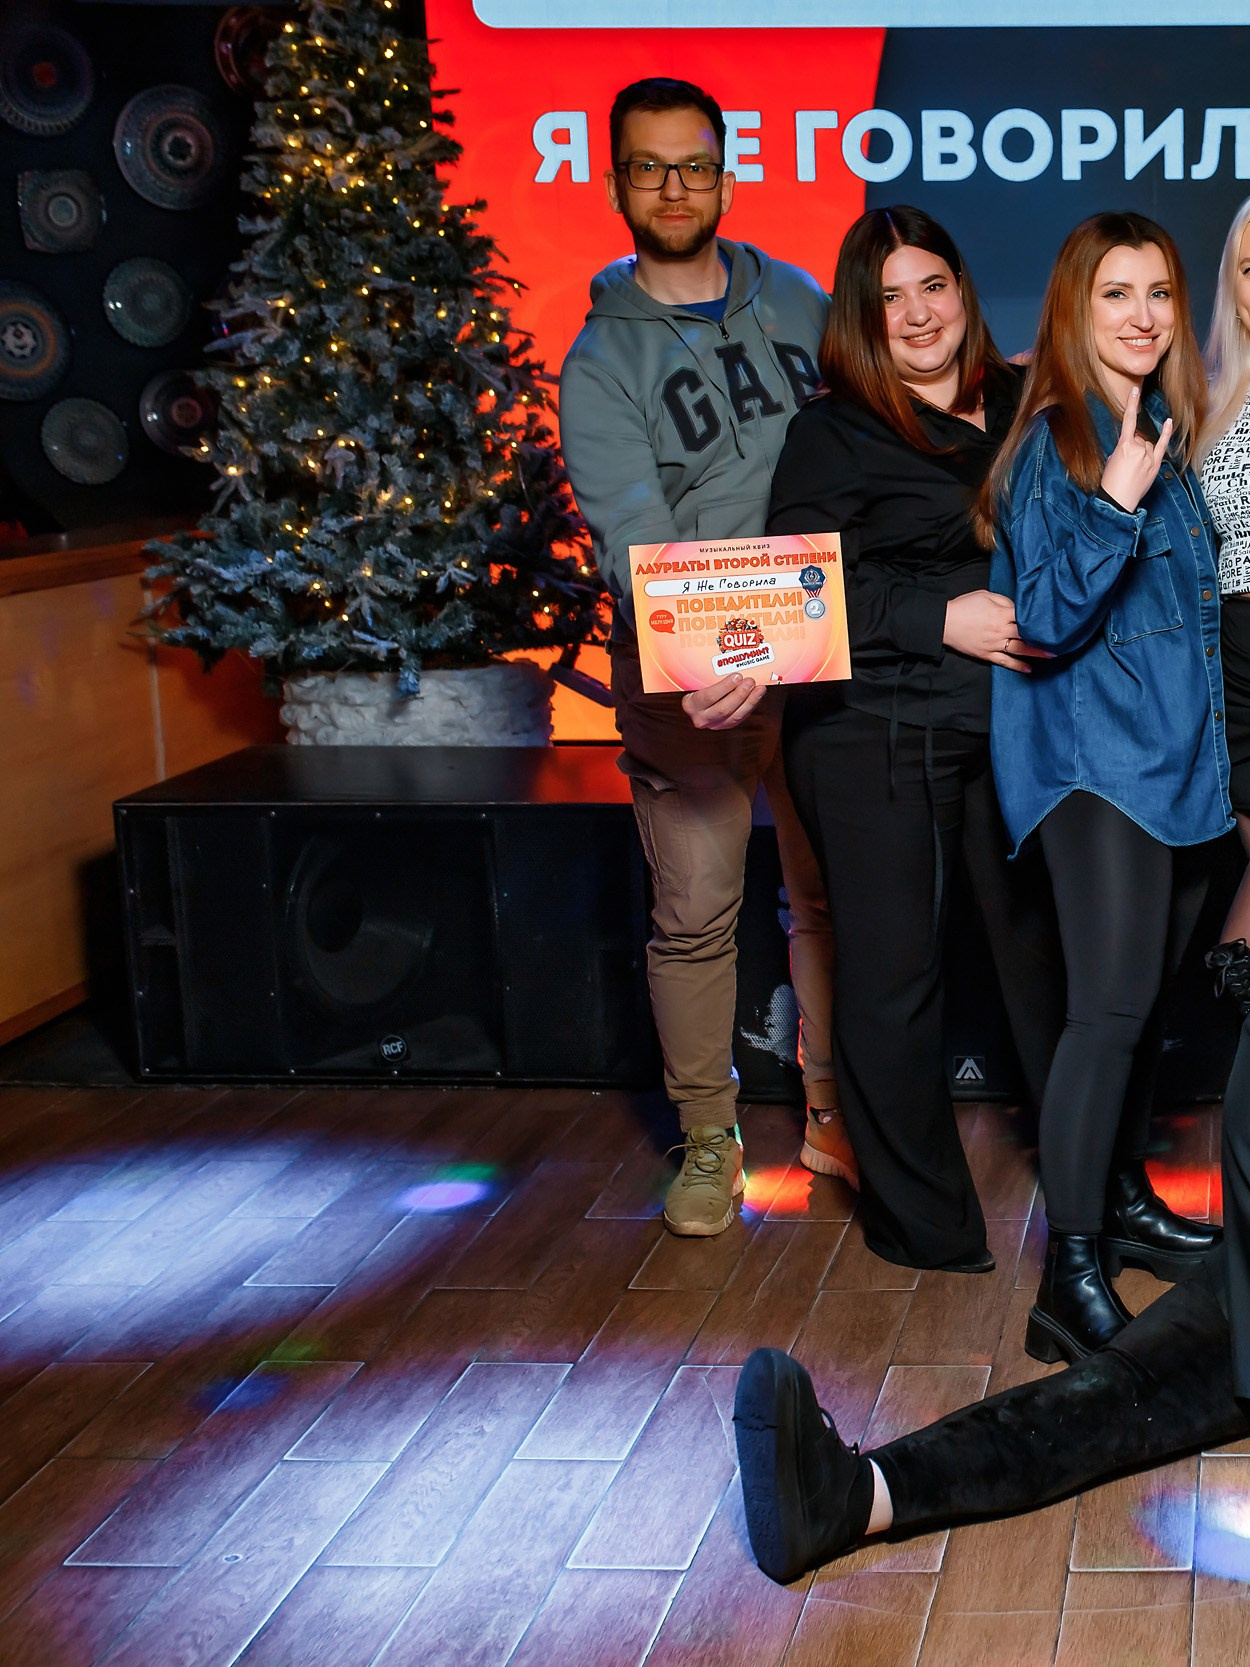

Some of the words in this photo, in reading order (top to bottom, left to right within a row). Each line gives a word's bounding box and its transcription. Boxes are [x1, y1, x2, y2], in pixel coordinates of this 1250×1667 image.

[532, 110, 591, 183] Я
[721, 110, 765, 182] Е
[661, 340, 822, 453] GAP
[699, 544, 751, 553] МУЗЫКАЛЬНЫЙ
[753, 543, 771, 551] КВИЗ
[636, 560, 710, 575] ЛАУРЕАТЫ
[714, 553, 771, 570] ВТОРОЙ
[774, 551, 837, 566] СТЕПЕНИ
[682, 581, 691, 594] Я
[677, 592, 803, 613] ПОБЕДИТЕЛИ!
[724, 633, 757, 648] QUIZ
[383, 1041, 404, 1056] RCF
